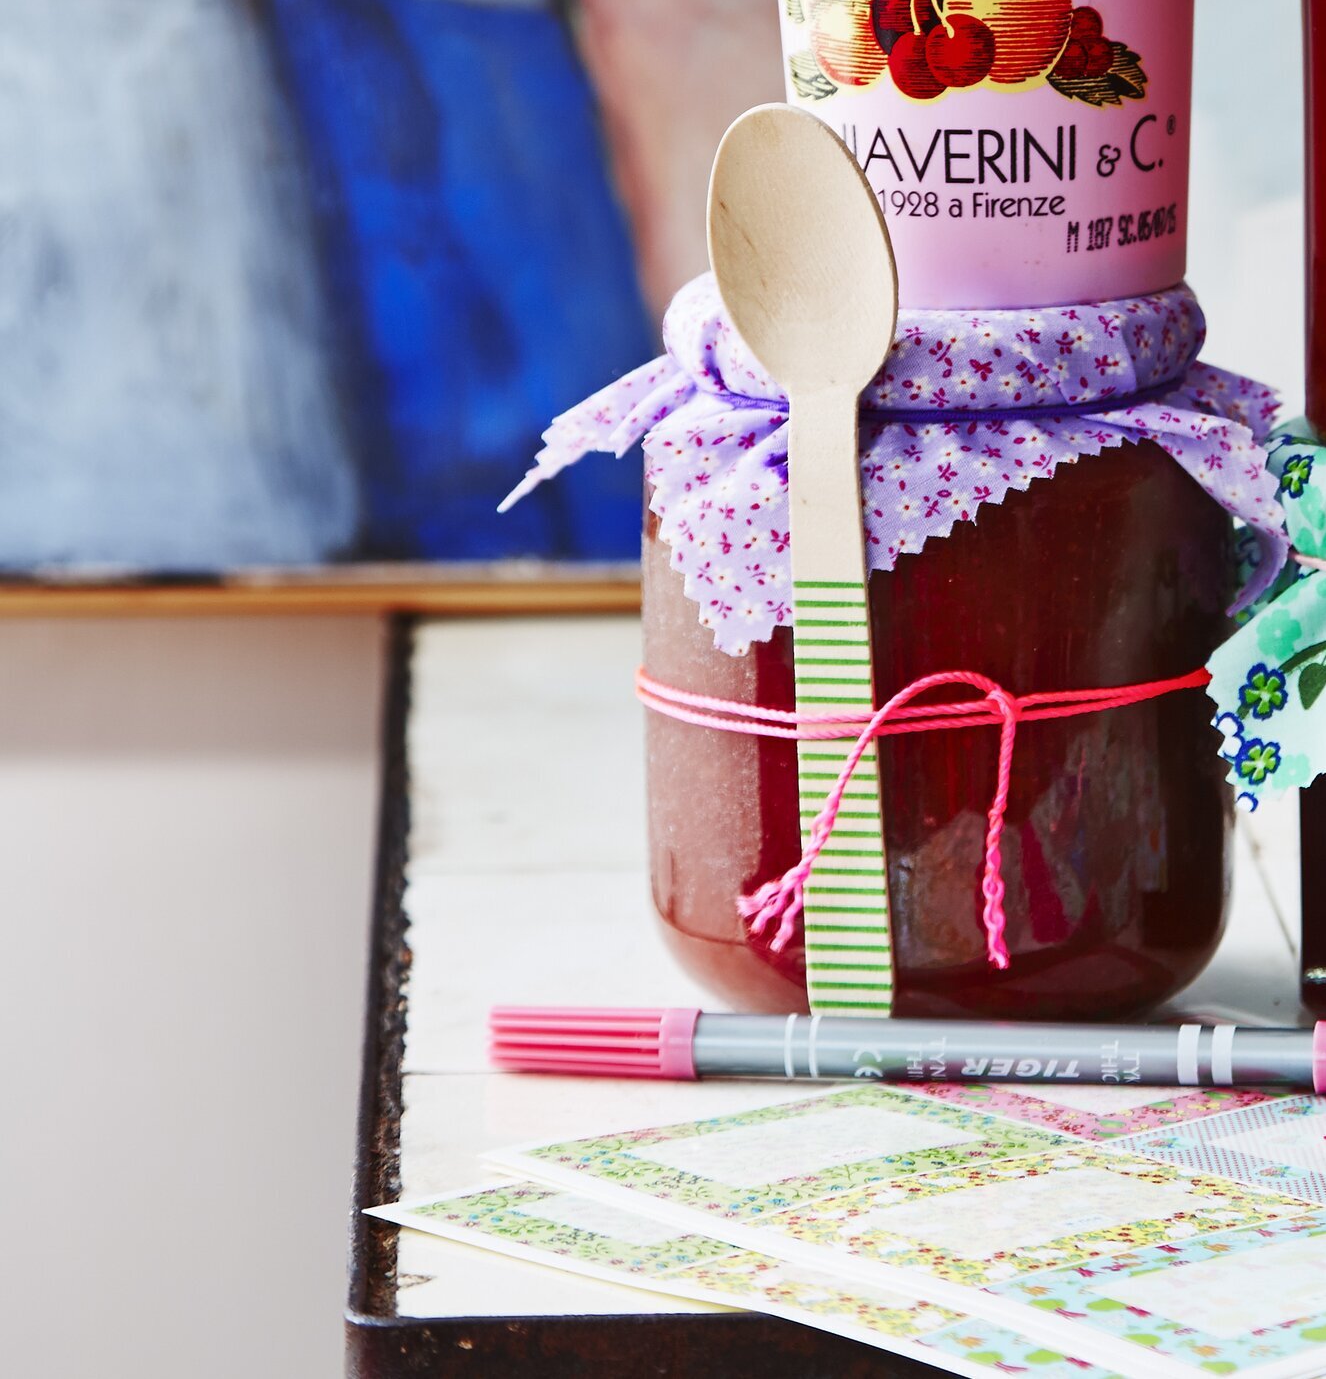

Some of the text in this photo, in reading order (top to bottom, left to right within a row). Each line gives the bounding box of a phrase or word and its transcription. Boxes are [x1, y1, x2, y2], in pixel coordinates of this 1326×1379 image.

[1096, 144, 1121, 177] &
[877, 188, 1066, 219] 1928 a Firenze
[961, 1057, 1080, 1079] TIGER
